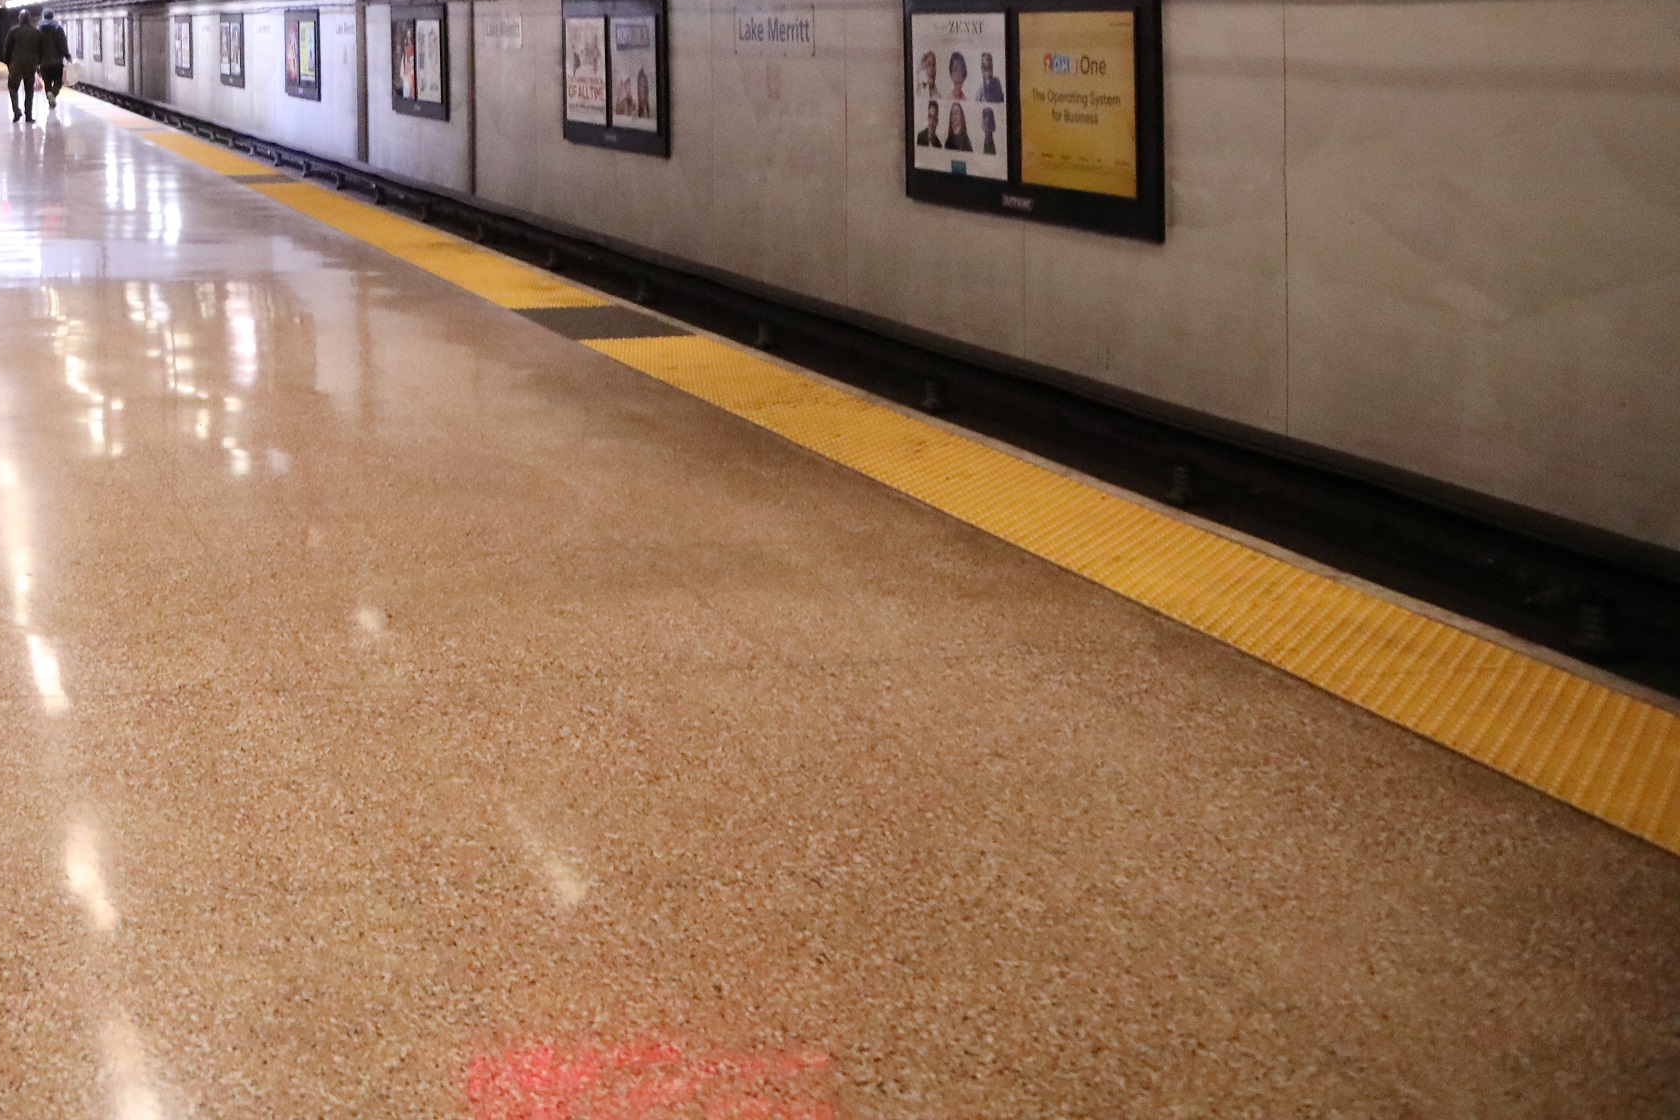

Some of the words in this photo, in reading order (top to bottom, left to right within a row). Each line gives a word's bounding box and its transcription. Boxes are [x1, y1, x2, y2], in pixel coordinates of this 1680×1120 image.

[739, 16, 764, 41] Lake
[768, 16, 810, 42] Merritt
[1080, 55, 1107, 75] One
[1047, 89, 1089, 108] Operating
[1090, 91, 1121, 109] System
[1064, 109, 1098, 126] Business
